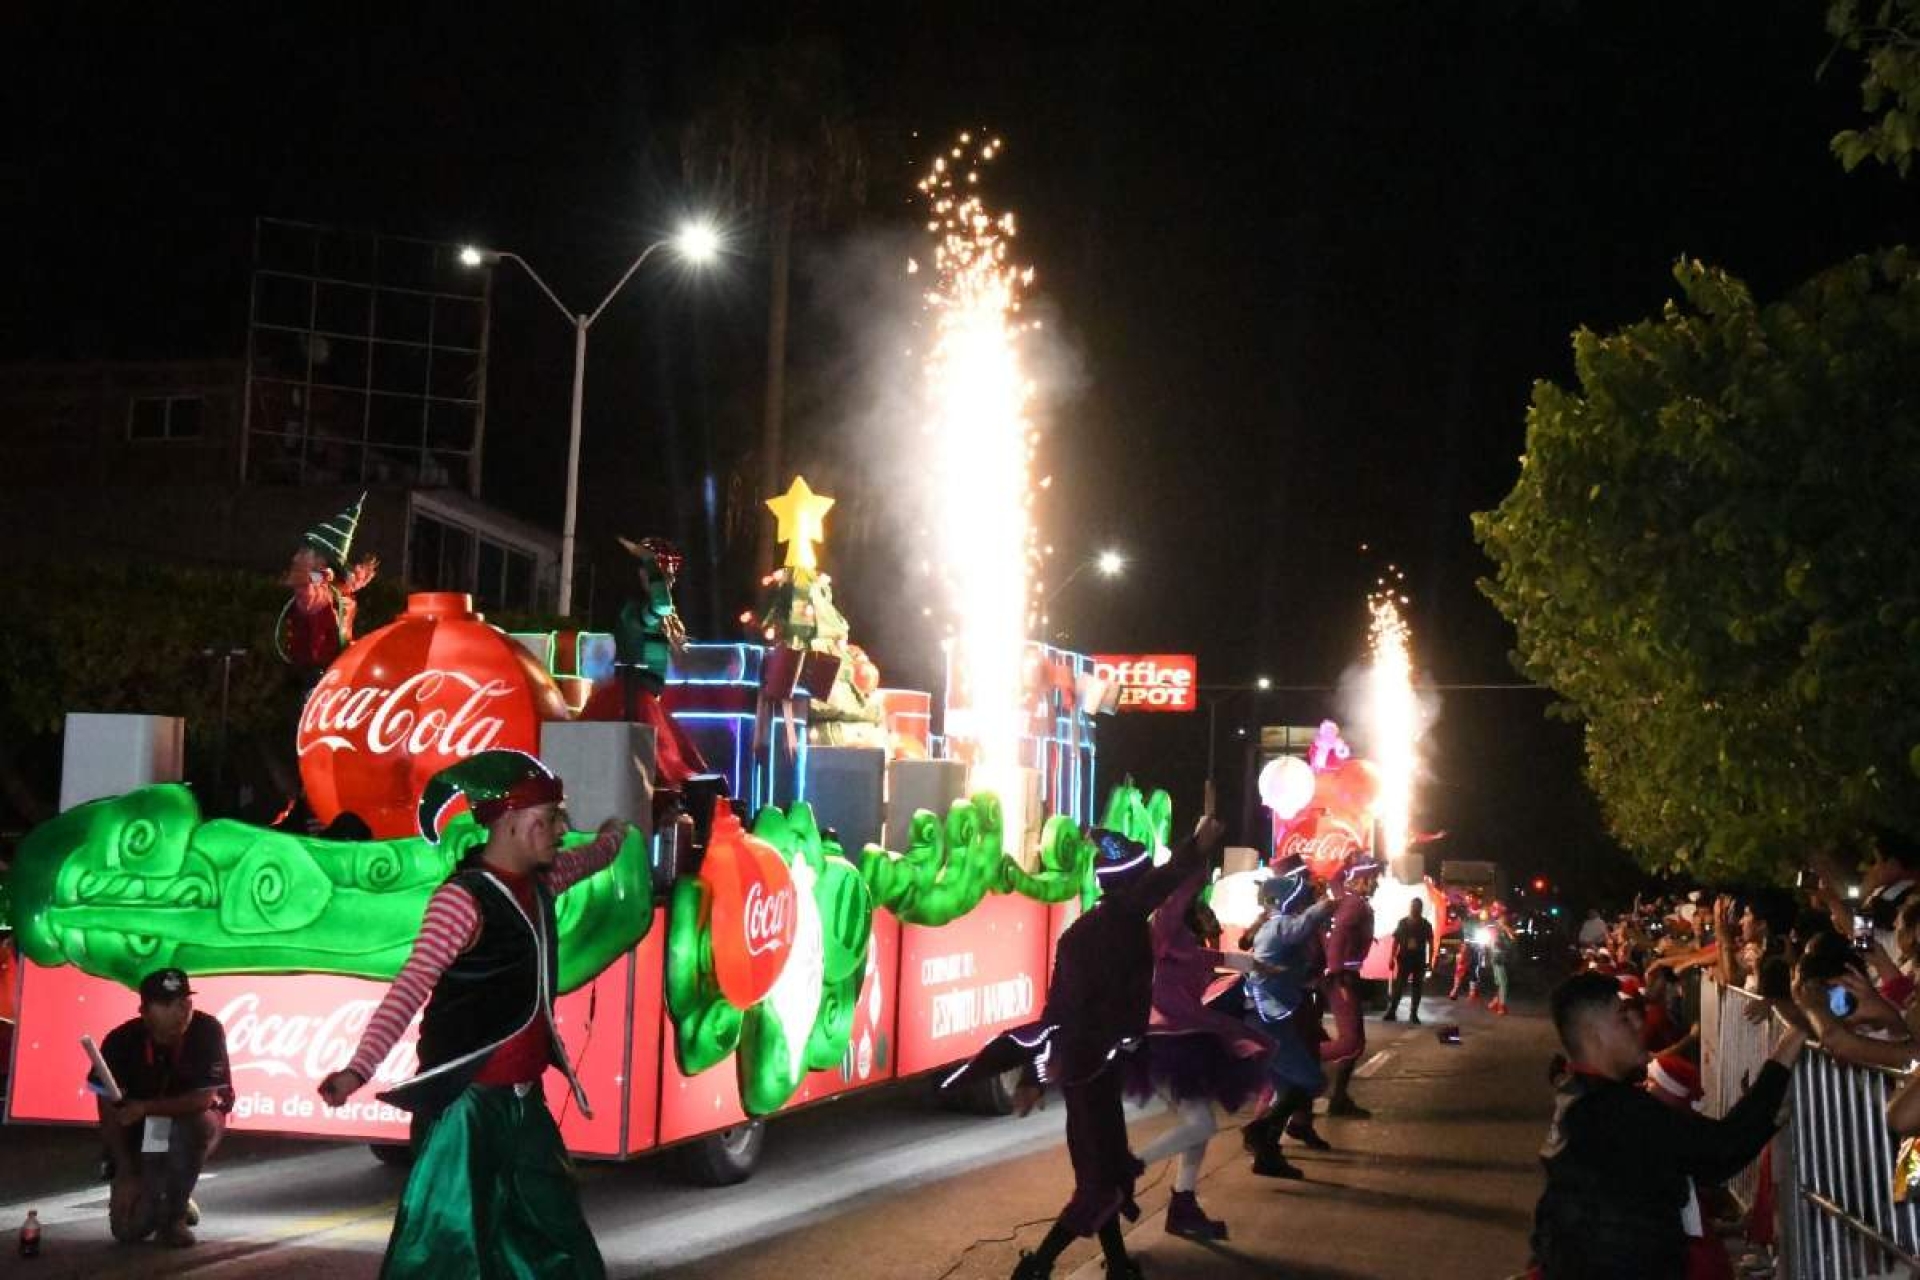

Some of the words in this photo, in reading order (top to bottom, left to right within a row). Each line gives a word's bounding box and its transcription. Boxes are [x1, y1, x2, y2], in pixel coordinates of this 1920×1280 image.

[1094, 661, 1191, 686] Office
[1118, 687, 1187, 705] EPOT
[296, 669, 516, 757] Coca-Cola
[282, 1095, 313, 1117] de
